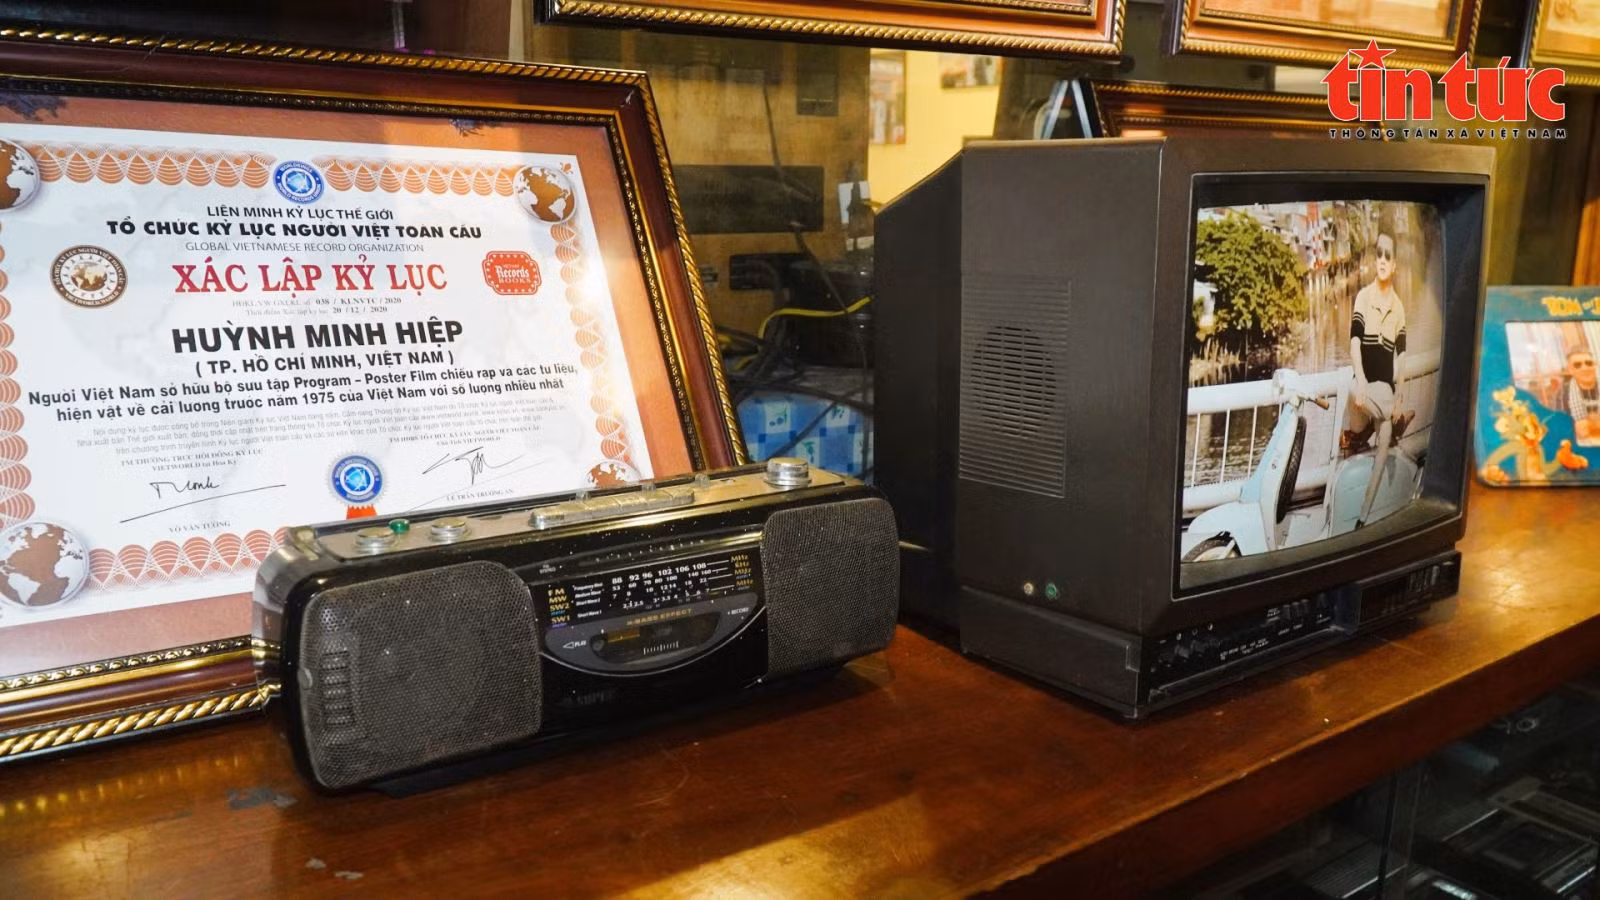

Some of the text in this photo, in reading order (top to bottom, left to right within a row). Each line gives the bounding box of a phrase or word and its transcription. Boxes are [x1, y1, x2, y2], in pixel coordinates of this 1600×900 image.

[207, 205, 394, 221] LIÊN MINH KỶ LỤC THẾ GIỚI
[107, 215, 136, 234] TỔ
[143, 219, 200, 235] CHỨC
[206, 219, 232, 236] KỶ
[240, 223, 276, 239] LỤC
[282, 222, 346, 237] NGƯỜI
[352, 223, 390, 240] VIỆT
[395, 224, 444, 238] TOÀN
[185, 241, 424, 252] GLOBAL VIETNAMESE RECORD ORGANIZATION
[171, 254, 447, 298] XÁC LẬP KỶ LỤC
[495, 265, 530, 278] Records
[172, 315, 463, 353] HUỲNH MINH HIỆP
[207, 360, 237, 374] TP.
[242, 353, 269, 372] HỒ
[274, 352, 306, 371] CHÍ
[311, 354, 362, 369] MINH,
[365, 350, 402, 368] VIỆT
[408, 351, 444, 364] NAM
[81, 387, 115, 403] Việt
[119, 386, 155, 399] Nam
[214, 381, 232, 396] bộ
[267, 378, 290, 393] tập
[294, 376, 351, 390] Program
[364, 372, 407, 385] Poster
[410, 369, 437, 382] Film
[441, 367, 474, 380] chiếu
[477, 368, 496, 380] rạp
[56, 408, 92, 423] hiện
[97, 404, 122, 420] vật
[127, 402, 146, 417] về
[151, 400, 174, 416] cải
[267, 395, 298, 407] năm
[302, 392, 335, 405] 1975
[339, 389, 364, 403] của
[367, 386, 394, 402] Việt
[397, 387, 426, 399] Nam
[451, 381, 466, 395] số
[505, 379, 537, 392] nhiều
[658, 568, 673, 576] 102
[692, 563, 707, 571] 108
[549, 595, 567, 604] MW
[549, 603, 570, 611] SW2
[551, 615, 571, 624] SW1
